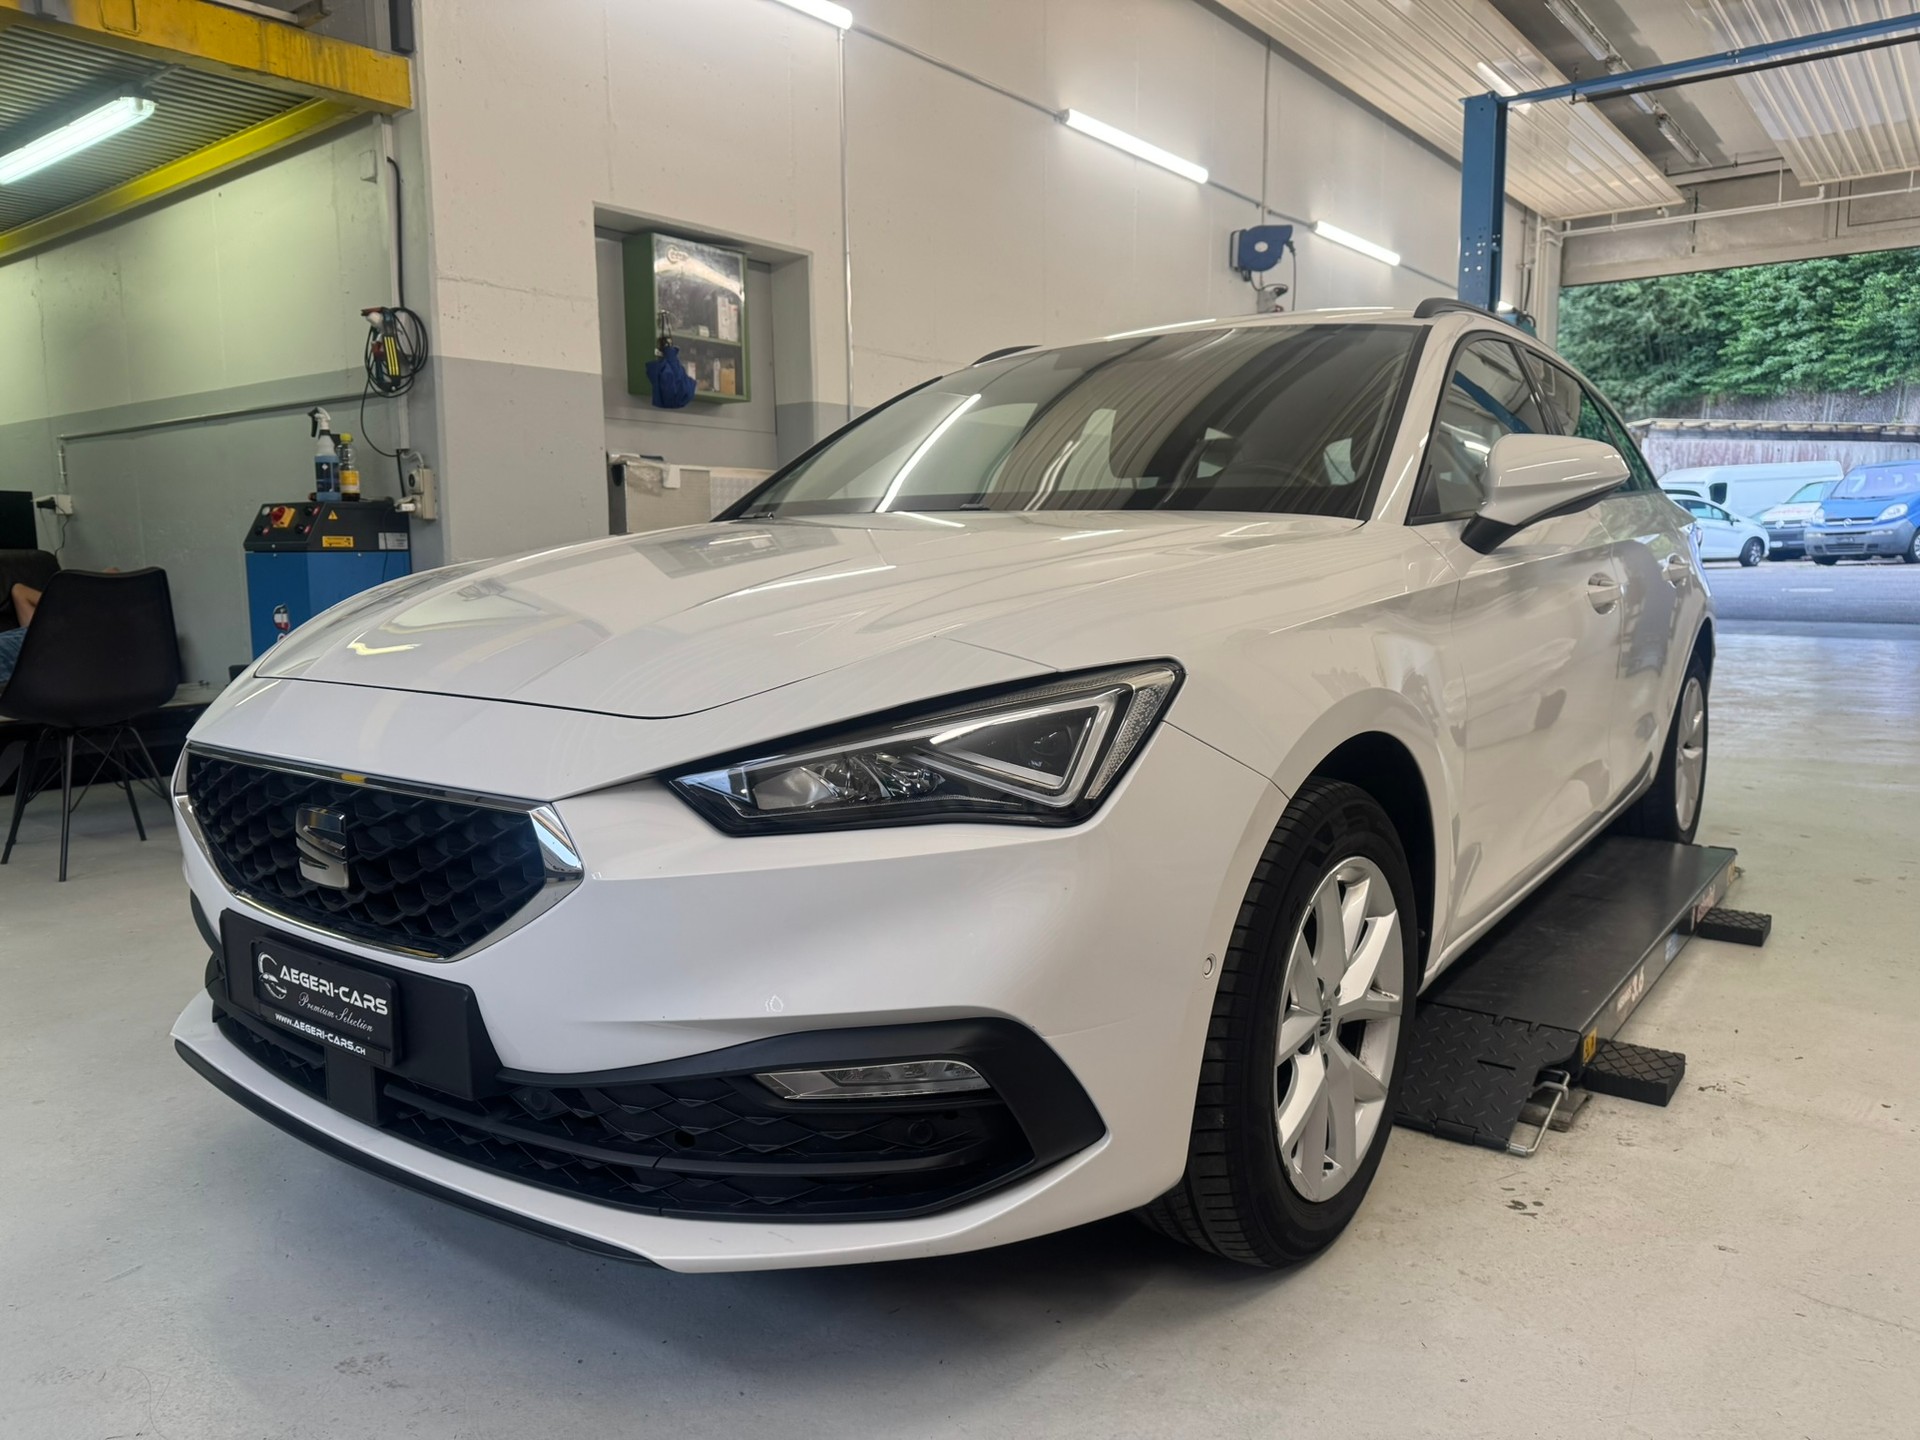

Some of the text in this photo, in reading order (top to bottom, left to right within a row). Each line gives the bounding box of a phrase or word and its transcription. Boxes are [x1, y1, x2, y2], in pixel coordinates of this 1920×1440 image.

[280, 965, 388, 1015] AEGERI-CARS
[298, 991, 373, 1032] Premium Selection
